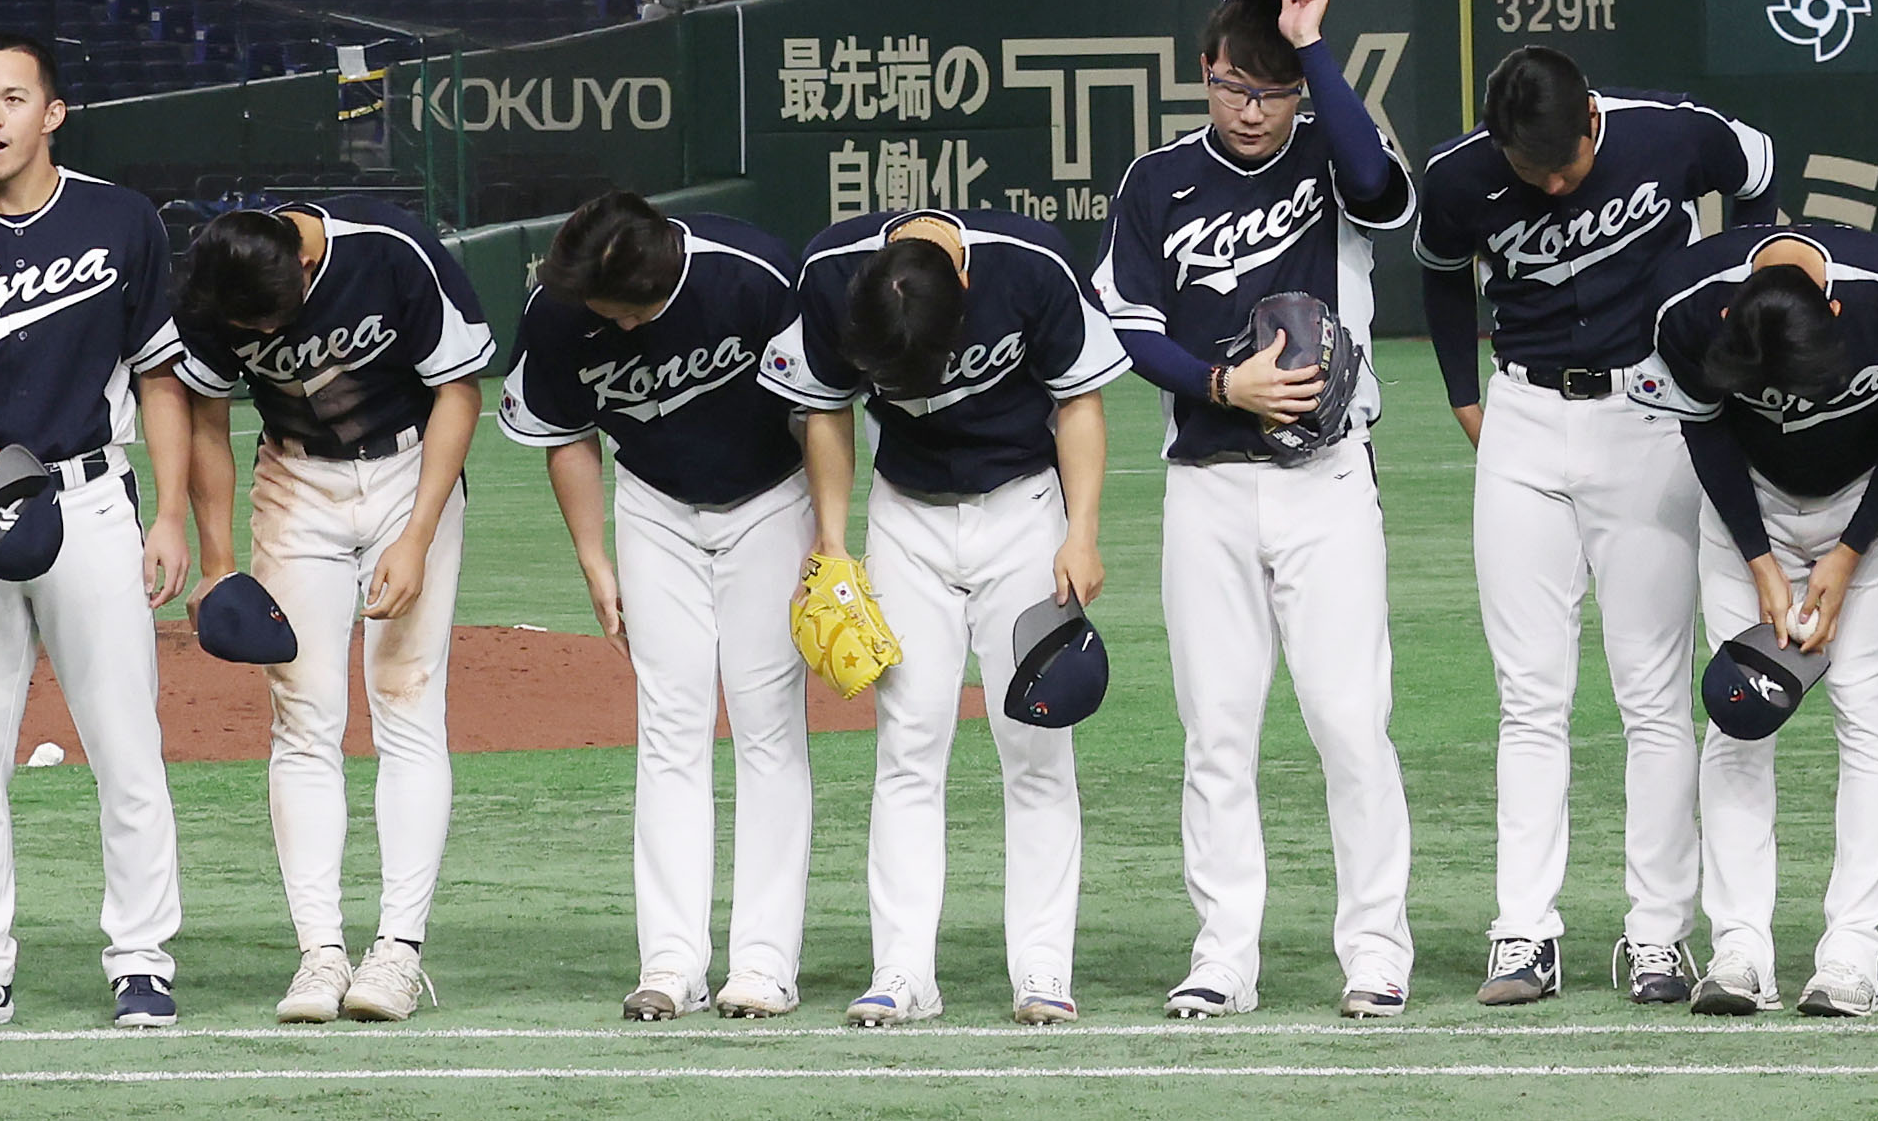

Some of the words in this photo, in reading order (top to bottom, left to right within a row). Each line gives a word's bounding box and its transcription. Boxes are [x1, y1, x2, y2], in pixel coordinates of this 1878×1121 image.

[411, 76, 671, 132] KOKUYO
[778, 34, 991, 123] 最先端の
[1005, 187, 1059, 222] The
[1164, 177, 1325, 292] Korea
[1489, 180, 1672, 285] Korea
[236, 313, 397, 399] Korea
[579, 334, 756, 422] Korea
